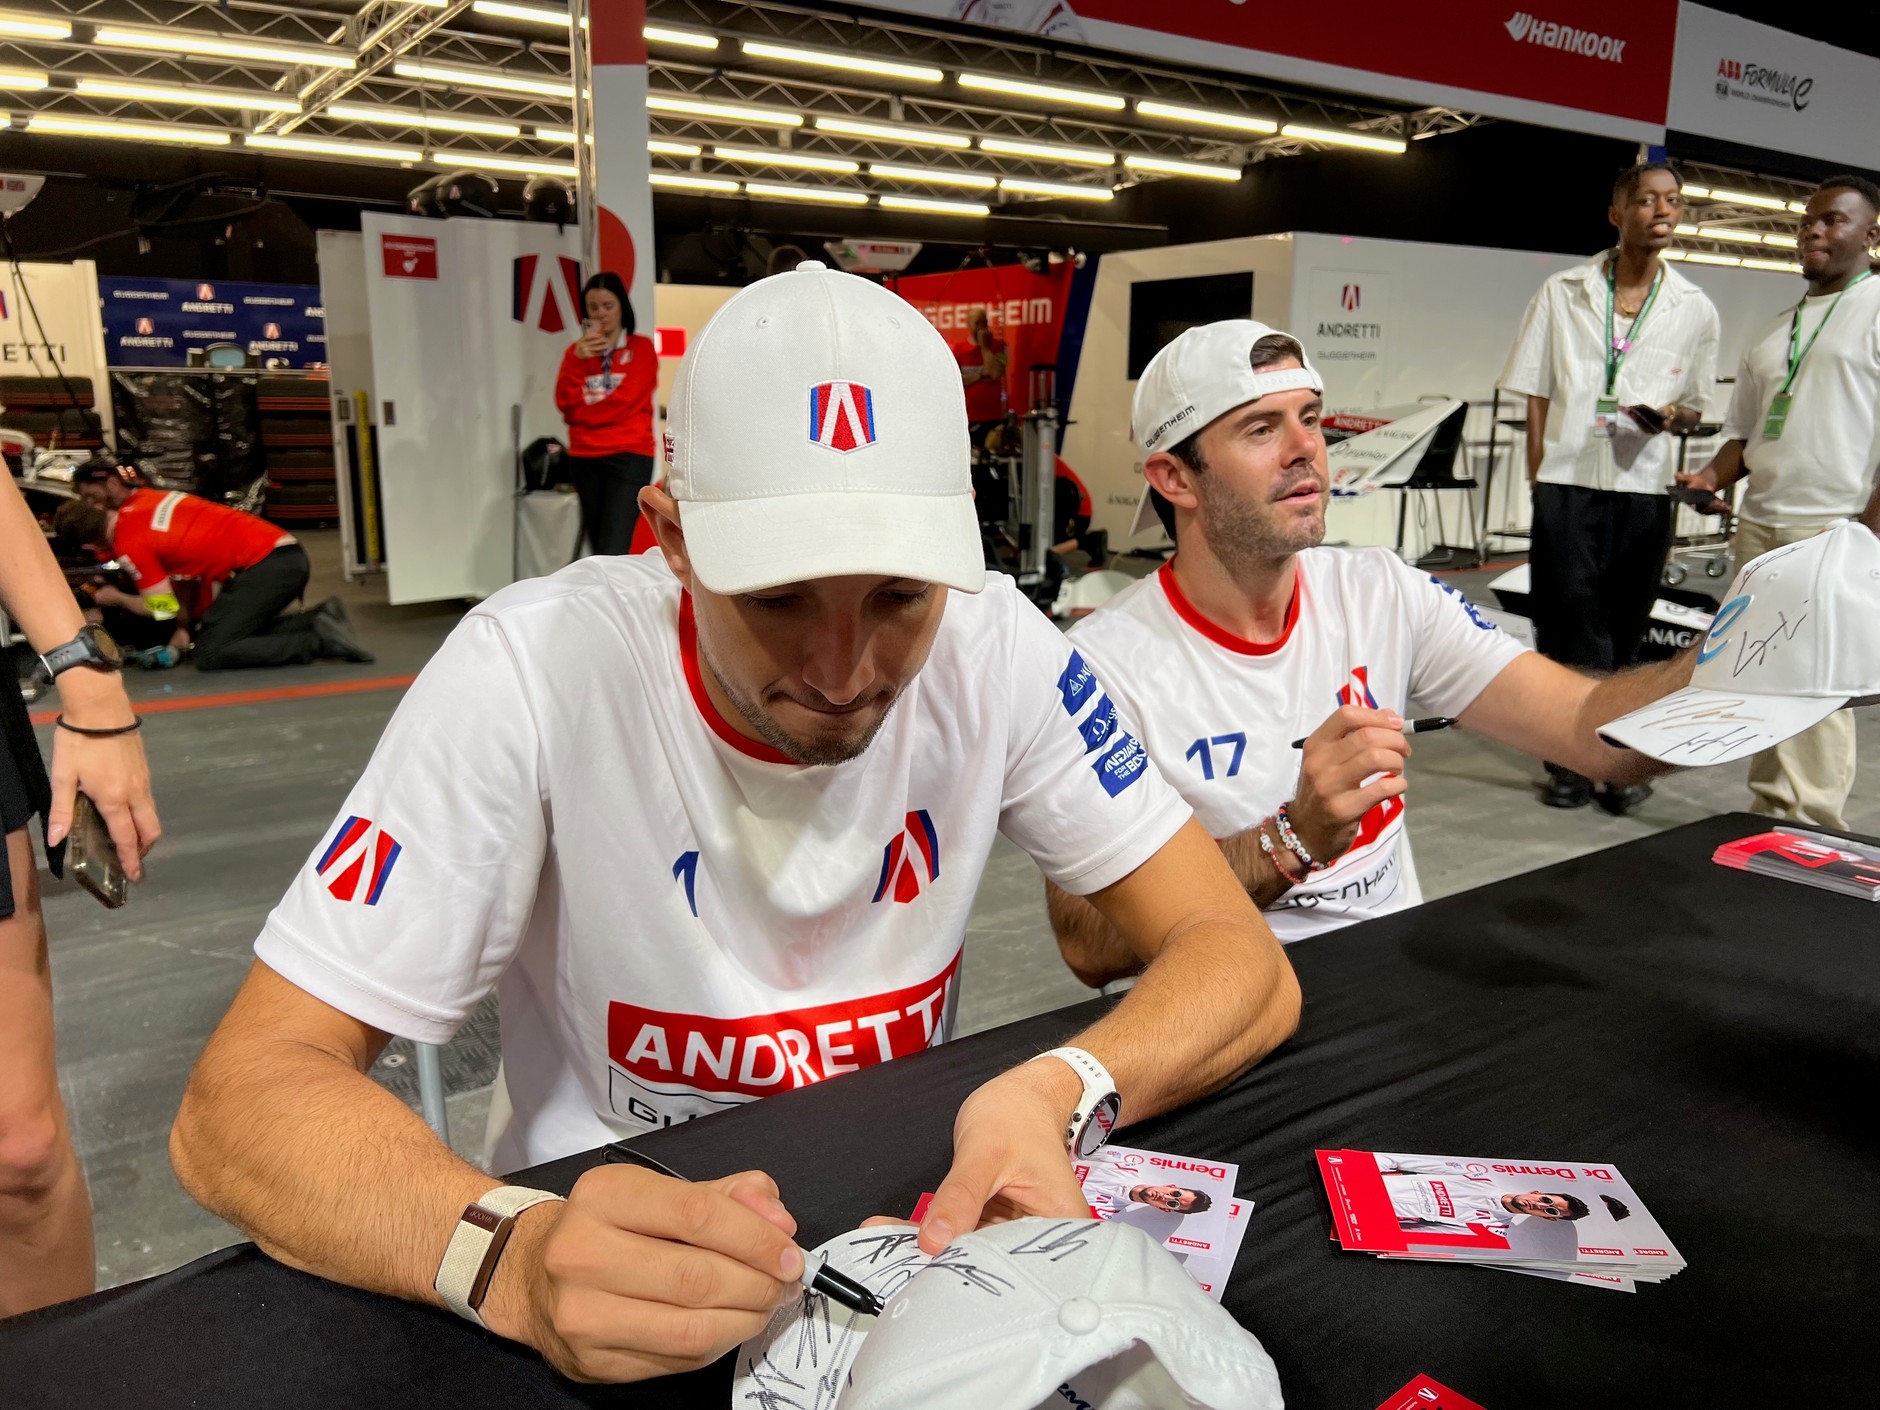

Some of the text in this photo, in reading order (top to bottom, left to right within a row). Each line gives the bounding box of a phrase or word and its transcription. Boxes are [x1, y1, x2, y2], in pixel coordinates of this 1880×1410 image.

[1317, 322, 1381, 339] ANDRETTI
[3, 343, 66, 363] ETTI
[1186, 731, 1248, 781] 17
[672, 850, 700, 917] 1
[1149, 1157, 1227, 1179] Dennis
[1491, 1164, 1577, 1180] Dennis
[1171, 1238, 1209, 1249] ANDRETTI
